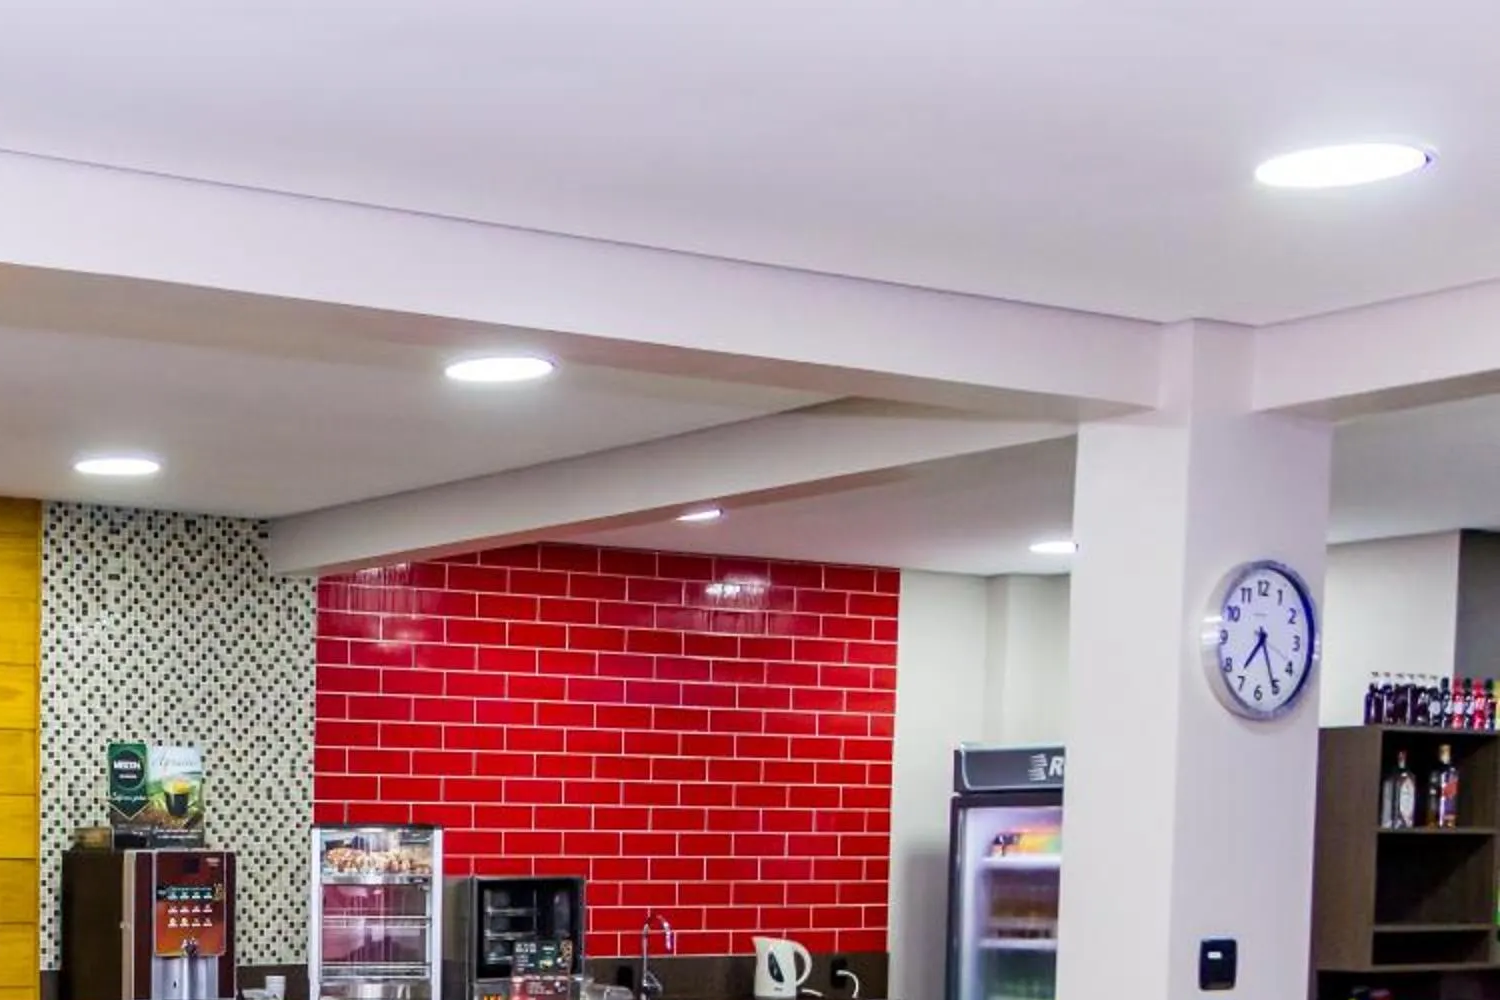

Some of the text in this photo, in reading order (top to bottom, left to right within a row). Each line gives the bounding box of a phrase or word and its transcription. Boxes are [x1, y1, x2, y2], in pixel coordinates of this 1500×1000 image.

[1240, 587, 1252, 603] 11
[1257, 580, 1270, 597] 12
[1277, 590, 1283, 606] 1
[1227, 606, 1240, 622] 10
[1288, 608, 1297, 624] 2
[1219, 629, 1228, 645] 9
[1293, 635, 1301, 651] 3
[1224, 656, 1233, 673] 8
[1284, 661, 1293, 677] 4
[1237, 675, 1246, 692] 7
[1272, 679, 1281, 695] 5
[1253, 684, 1263, 701] 6
